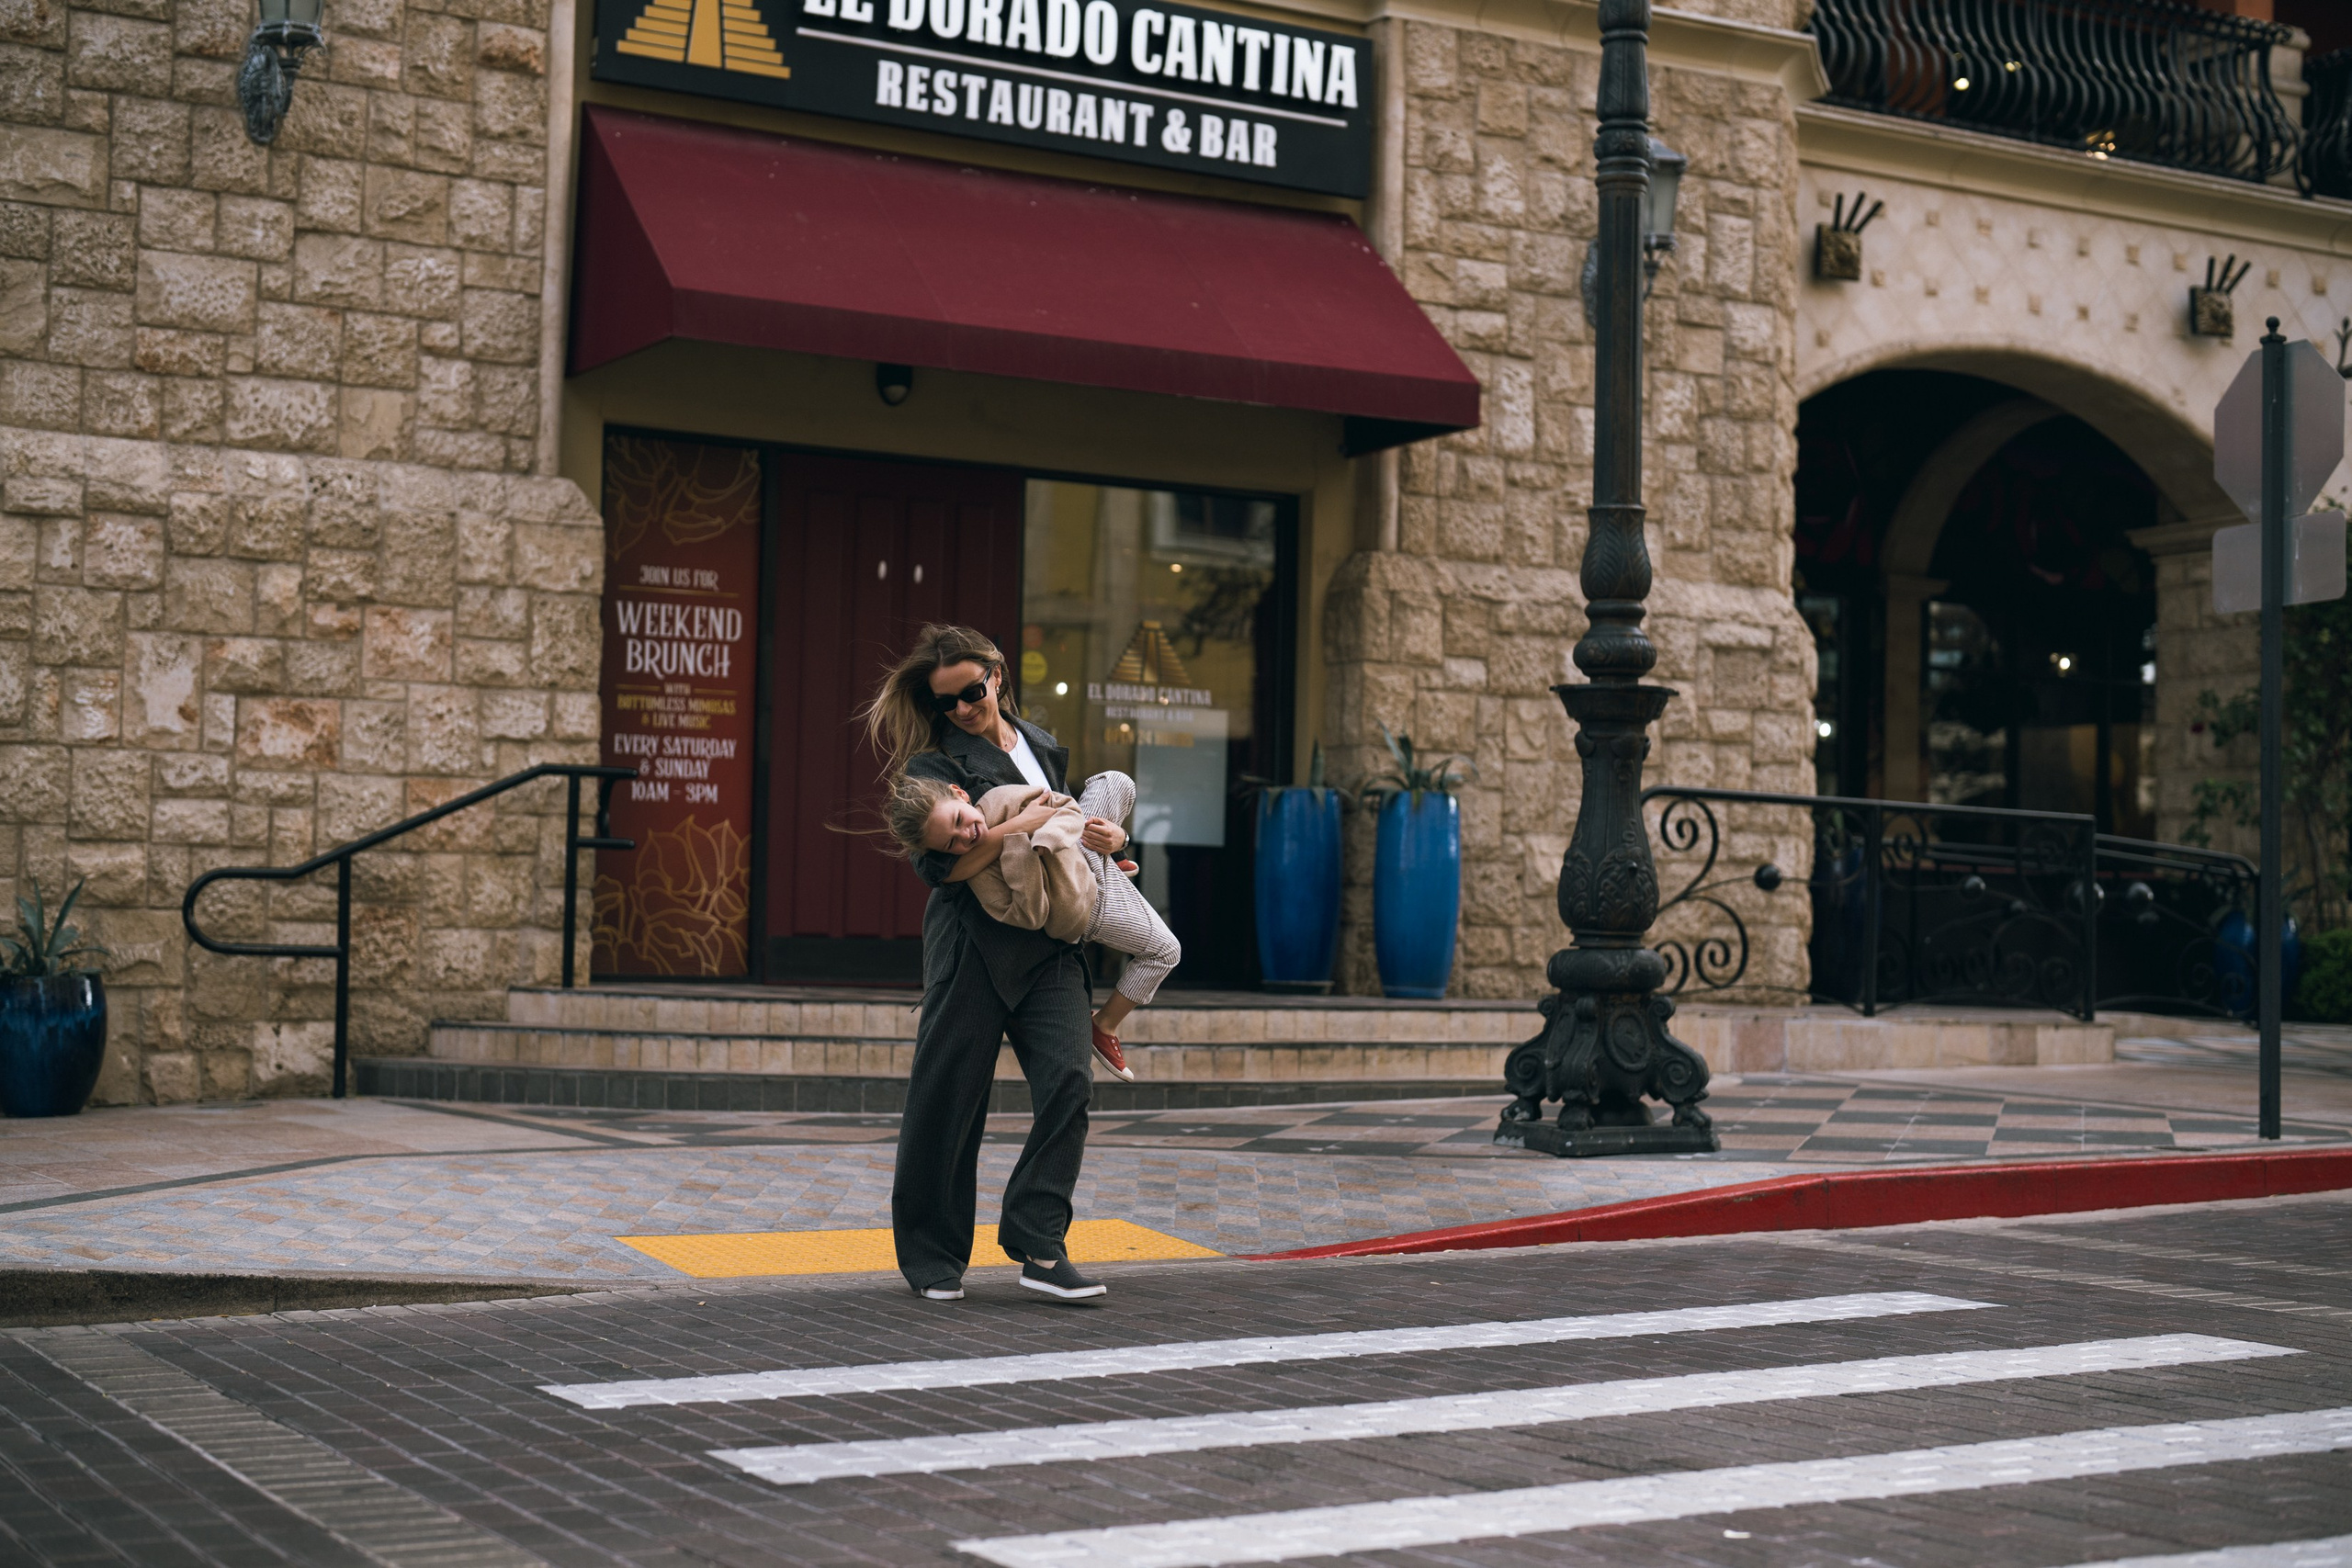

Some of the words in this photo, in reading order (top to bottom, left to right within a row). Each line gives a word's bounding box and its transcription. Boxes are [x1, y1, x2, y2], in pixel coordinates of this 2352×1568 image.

[1131, 8, 1358, 108] CANTINA
[876, 60, 1154, 147] RESTAURANT
[1161, 108, 1193, 154] &
[1199, 114, 1277, 167] BAR
[639, 564, 670, 586] JOIN
[673, 567, 692, 587] US
[694, 569, 719, 592] FOR
[616, 600, 742, 642] WEEKEND
[626, 638, 731, 680] BRUNCH
[616, 694, 686, 712] BOTTOMLESS
[687, 698, 736, 716] MIMOSAS
[652, 713, 676, 728] LIVE
[678, 714, 711, 729] MUSIC
[614, 733, 660, 759] EVERY
[662, 736, 737, 759] SATURDAY
[639, 758, 650, 776] &
[654, 757, 711, 780] SUNDAY
[631, 781, 669, 802] 10AM
[684, 783, 718, 805] 3PM
